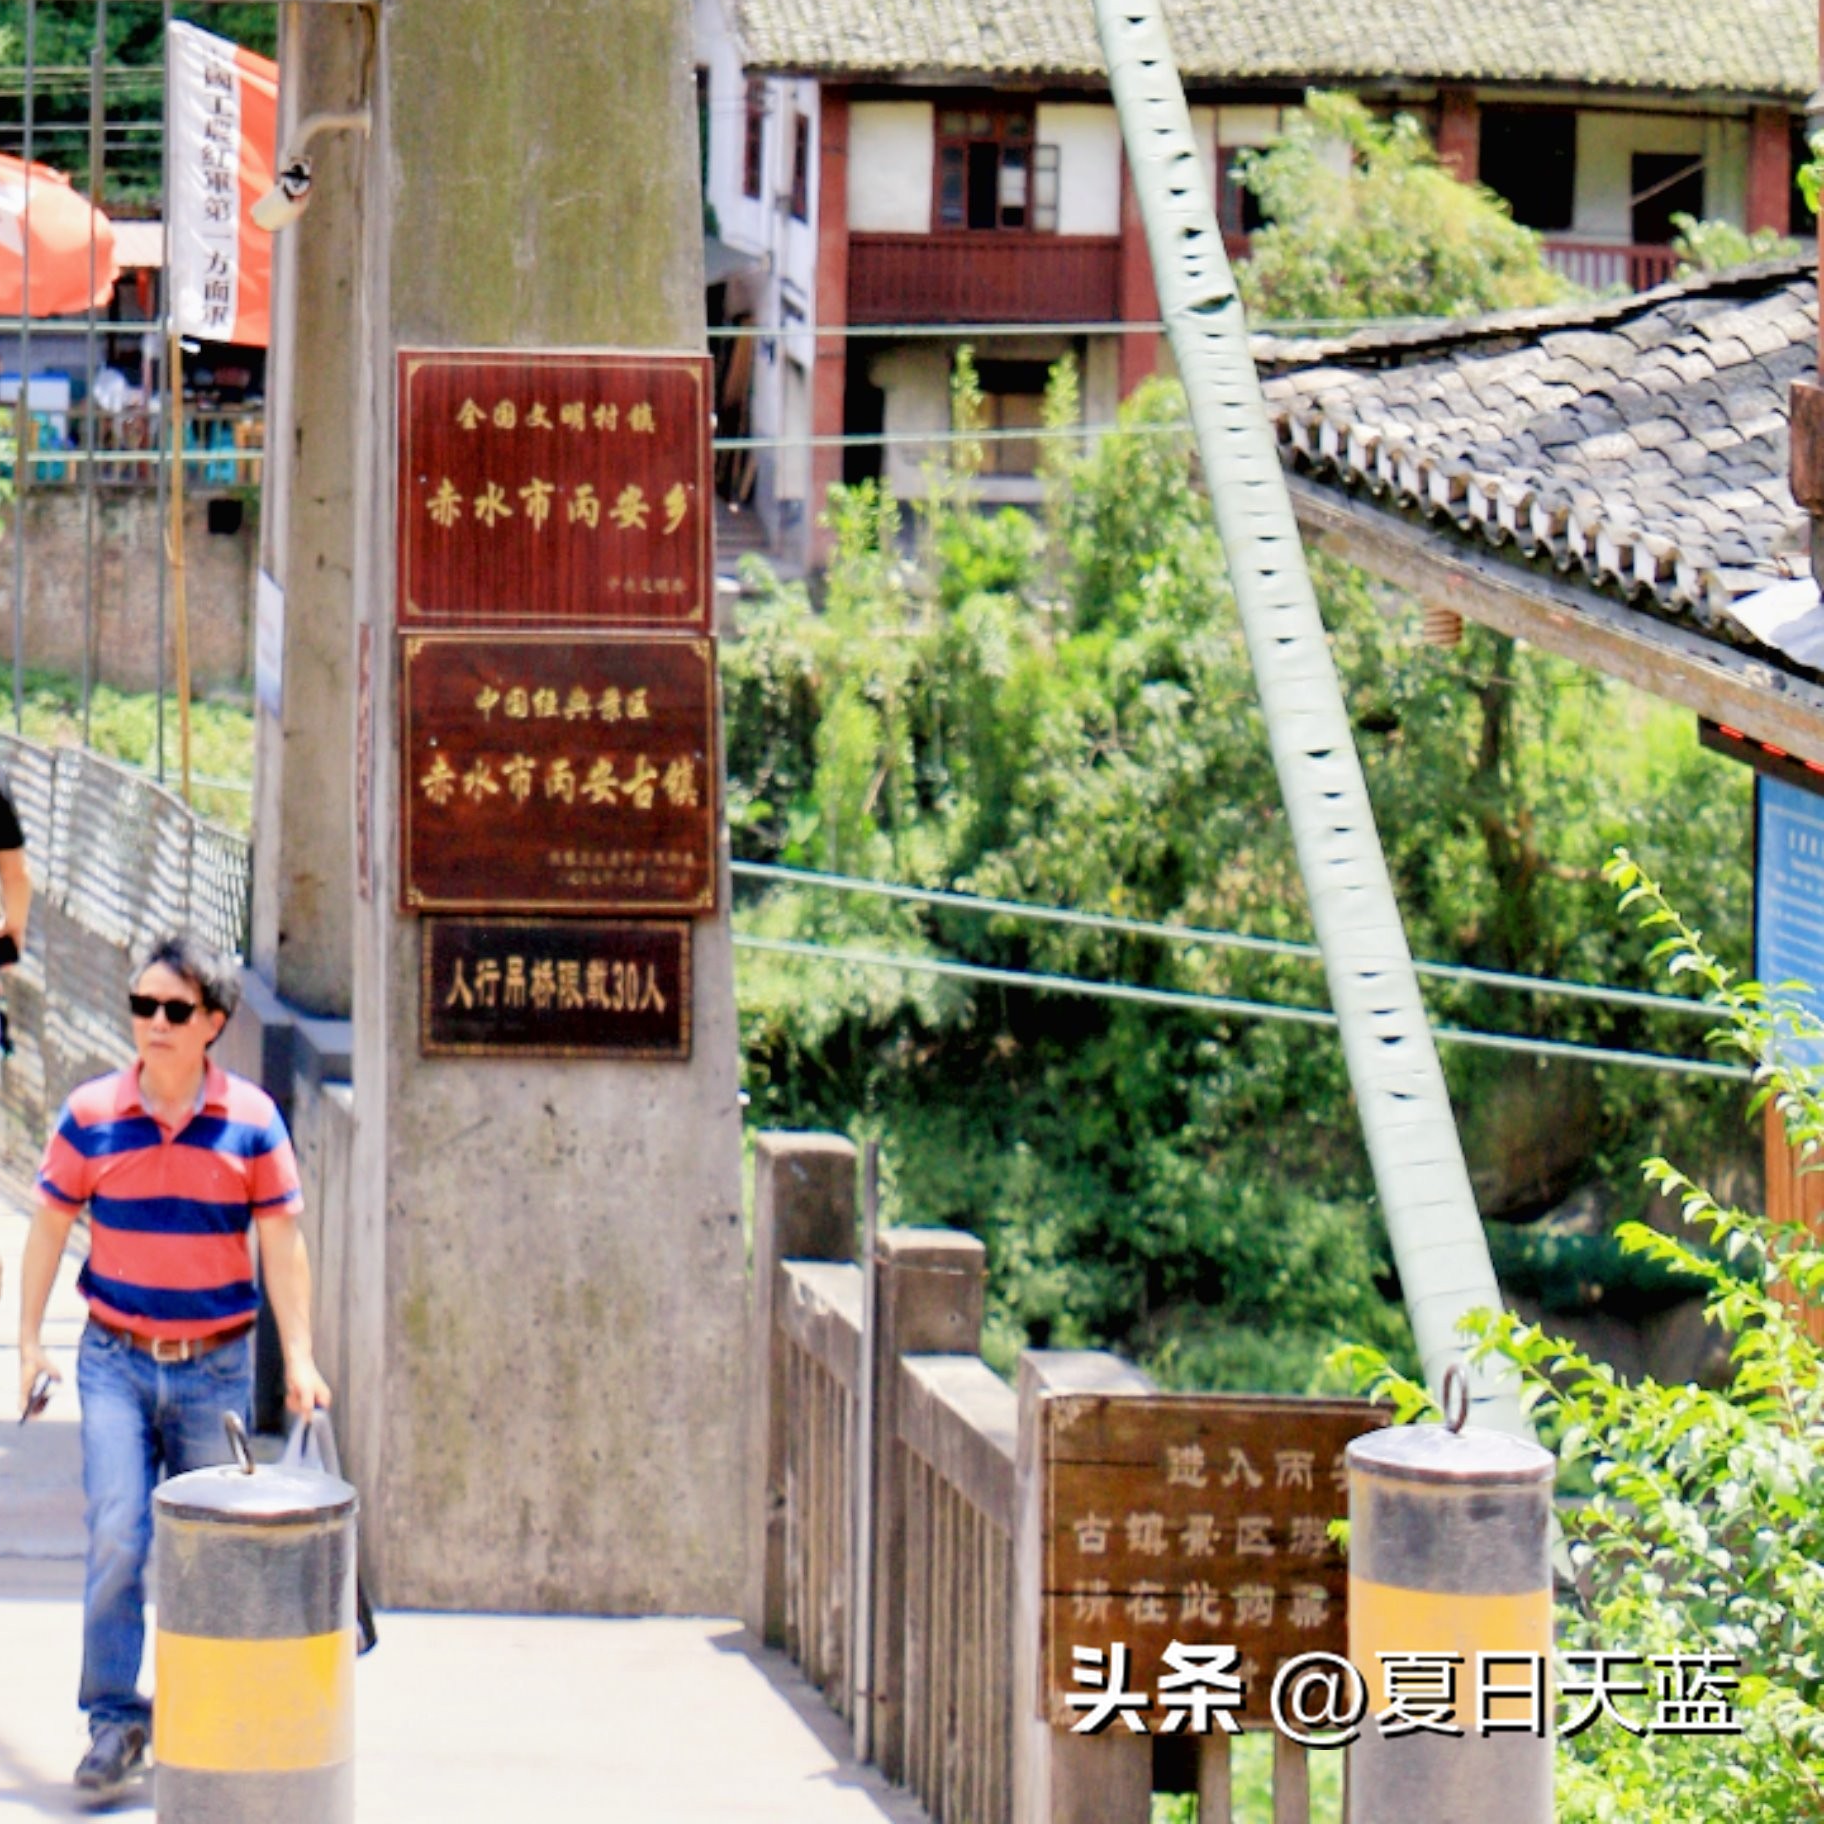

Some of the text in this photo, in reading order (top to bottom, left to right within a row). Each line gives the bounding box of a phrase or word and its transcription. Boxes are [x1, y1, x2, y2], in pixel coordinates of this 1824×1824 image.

[455, 397, 657, 434] 全国文明村镇
[426, 476, 689, 536] 赤水市丙安乡
[475, 685, 651, 723] 中国经典景区
[419, 752, 700, 810] 赤水市丙安古镇
[445, 954, 667, 1014] 人行吊桥限载30人
